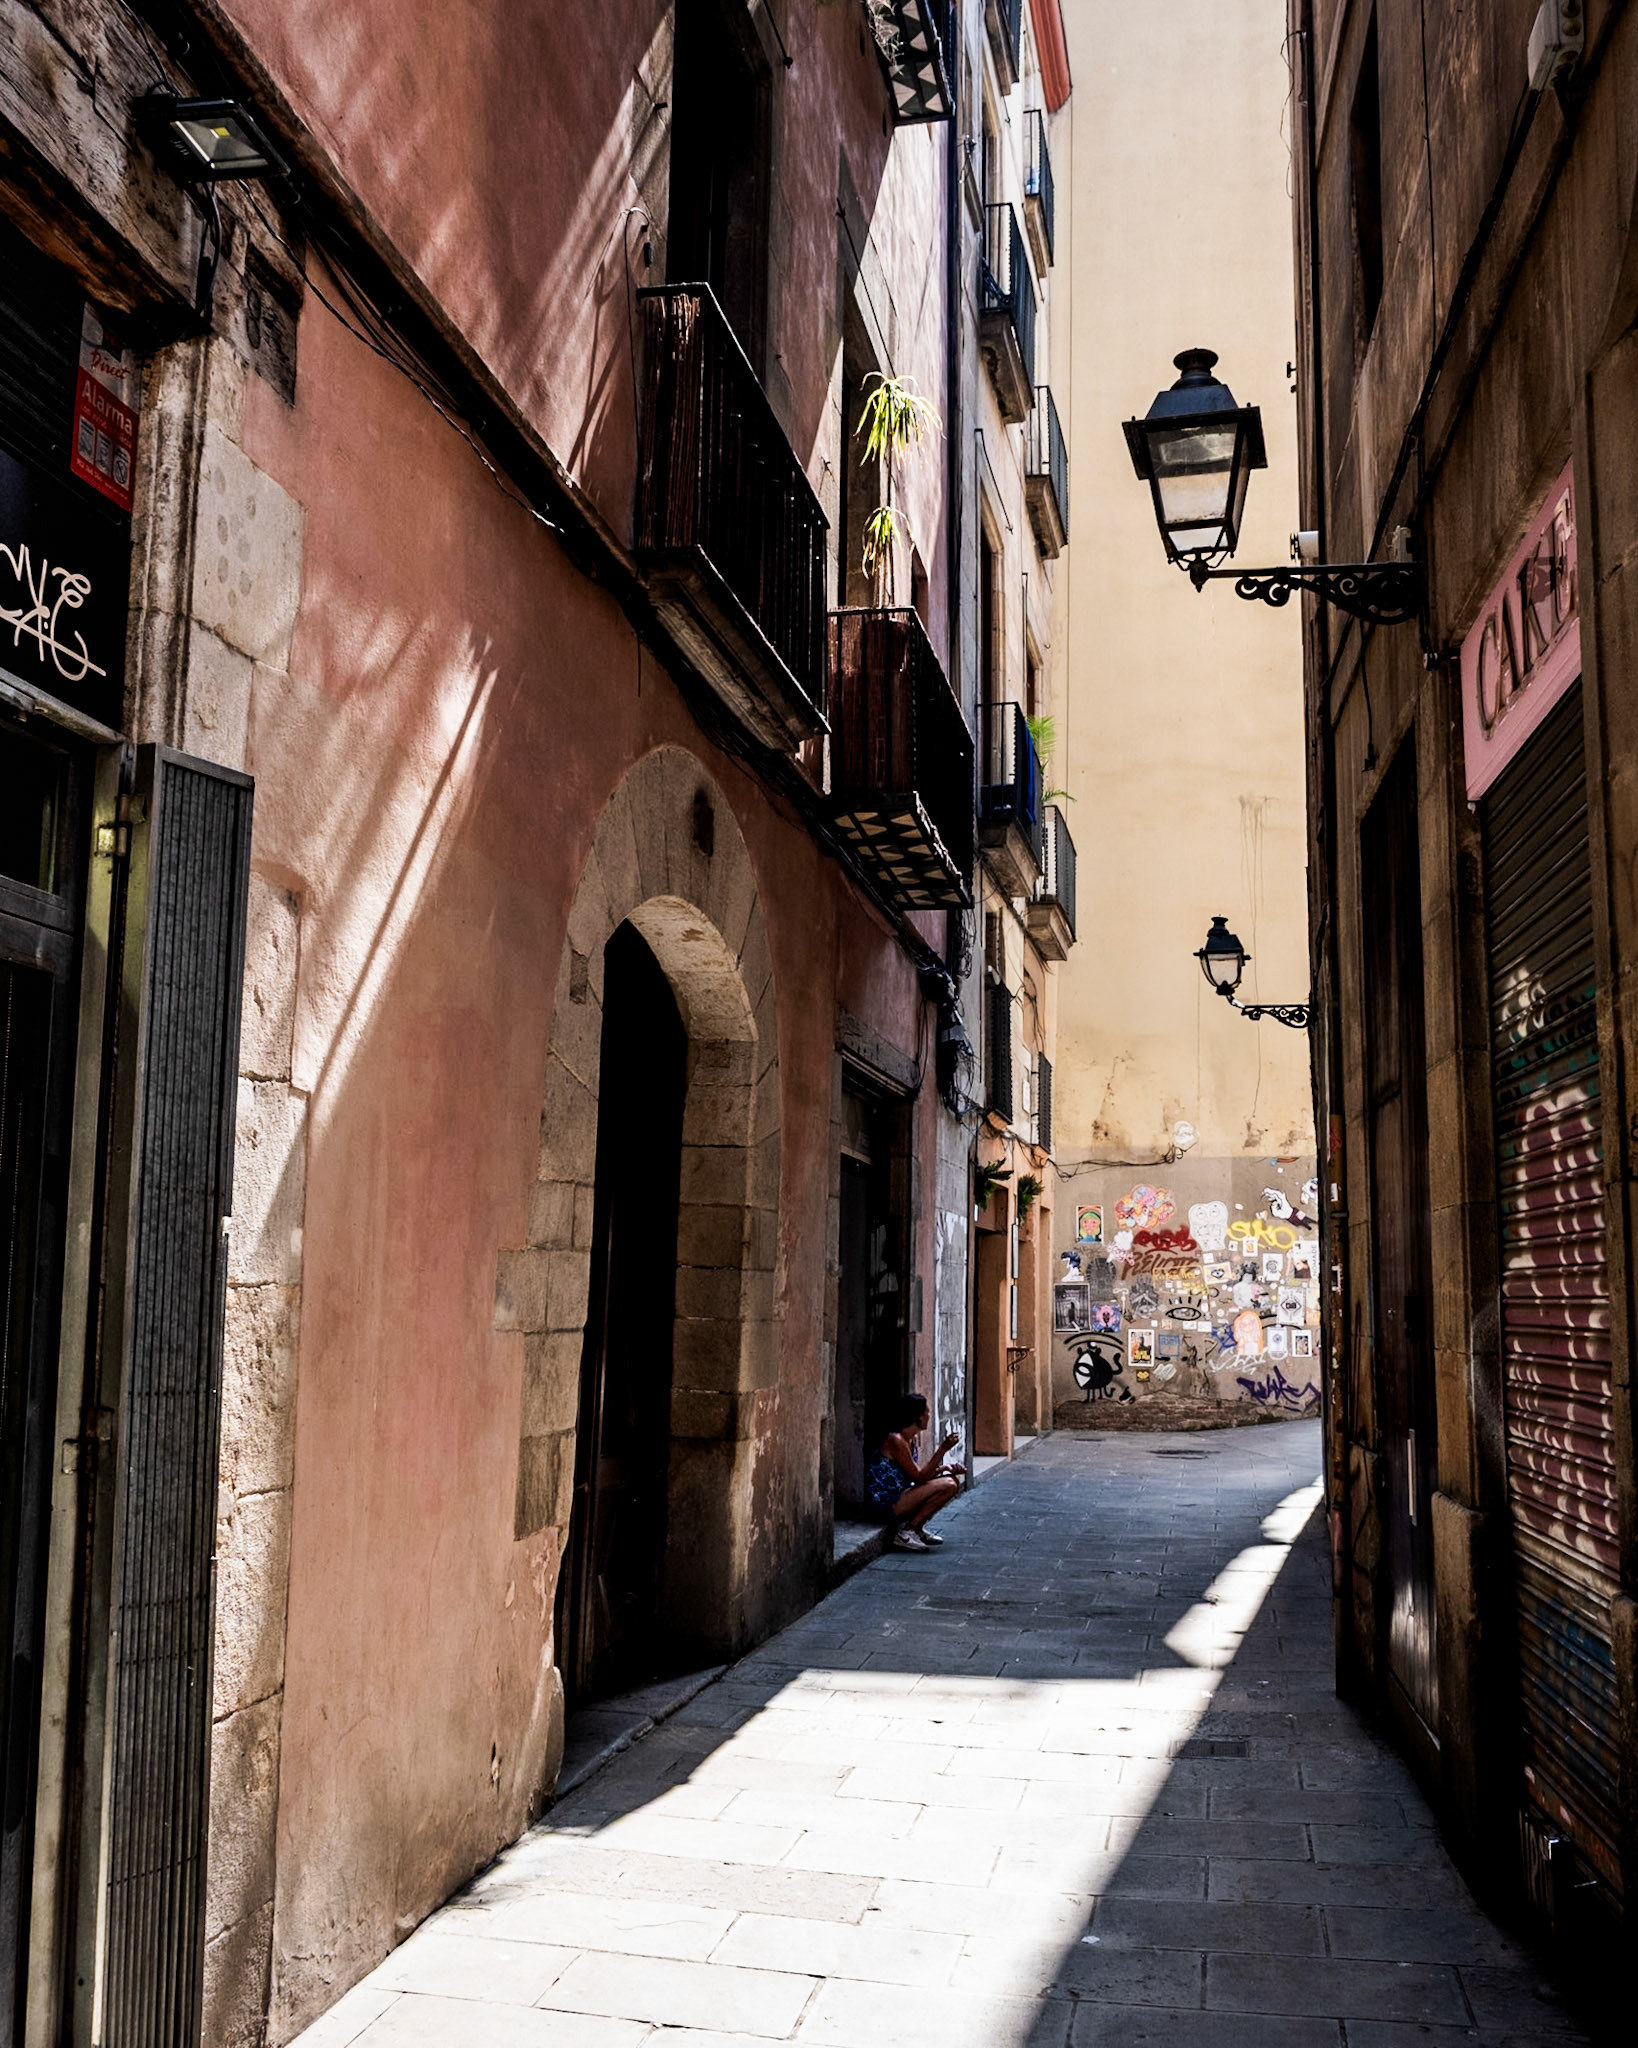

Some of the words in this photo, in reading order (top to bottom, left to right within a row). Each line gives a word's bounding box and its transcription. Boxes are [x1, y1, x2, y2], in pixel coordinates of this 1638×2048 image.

[90, 348, 131, 379] Direct
[81, 379, 133, 437] Alarma
[1477, 488, 1578, 740] CAKE
